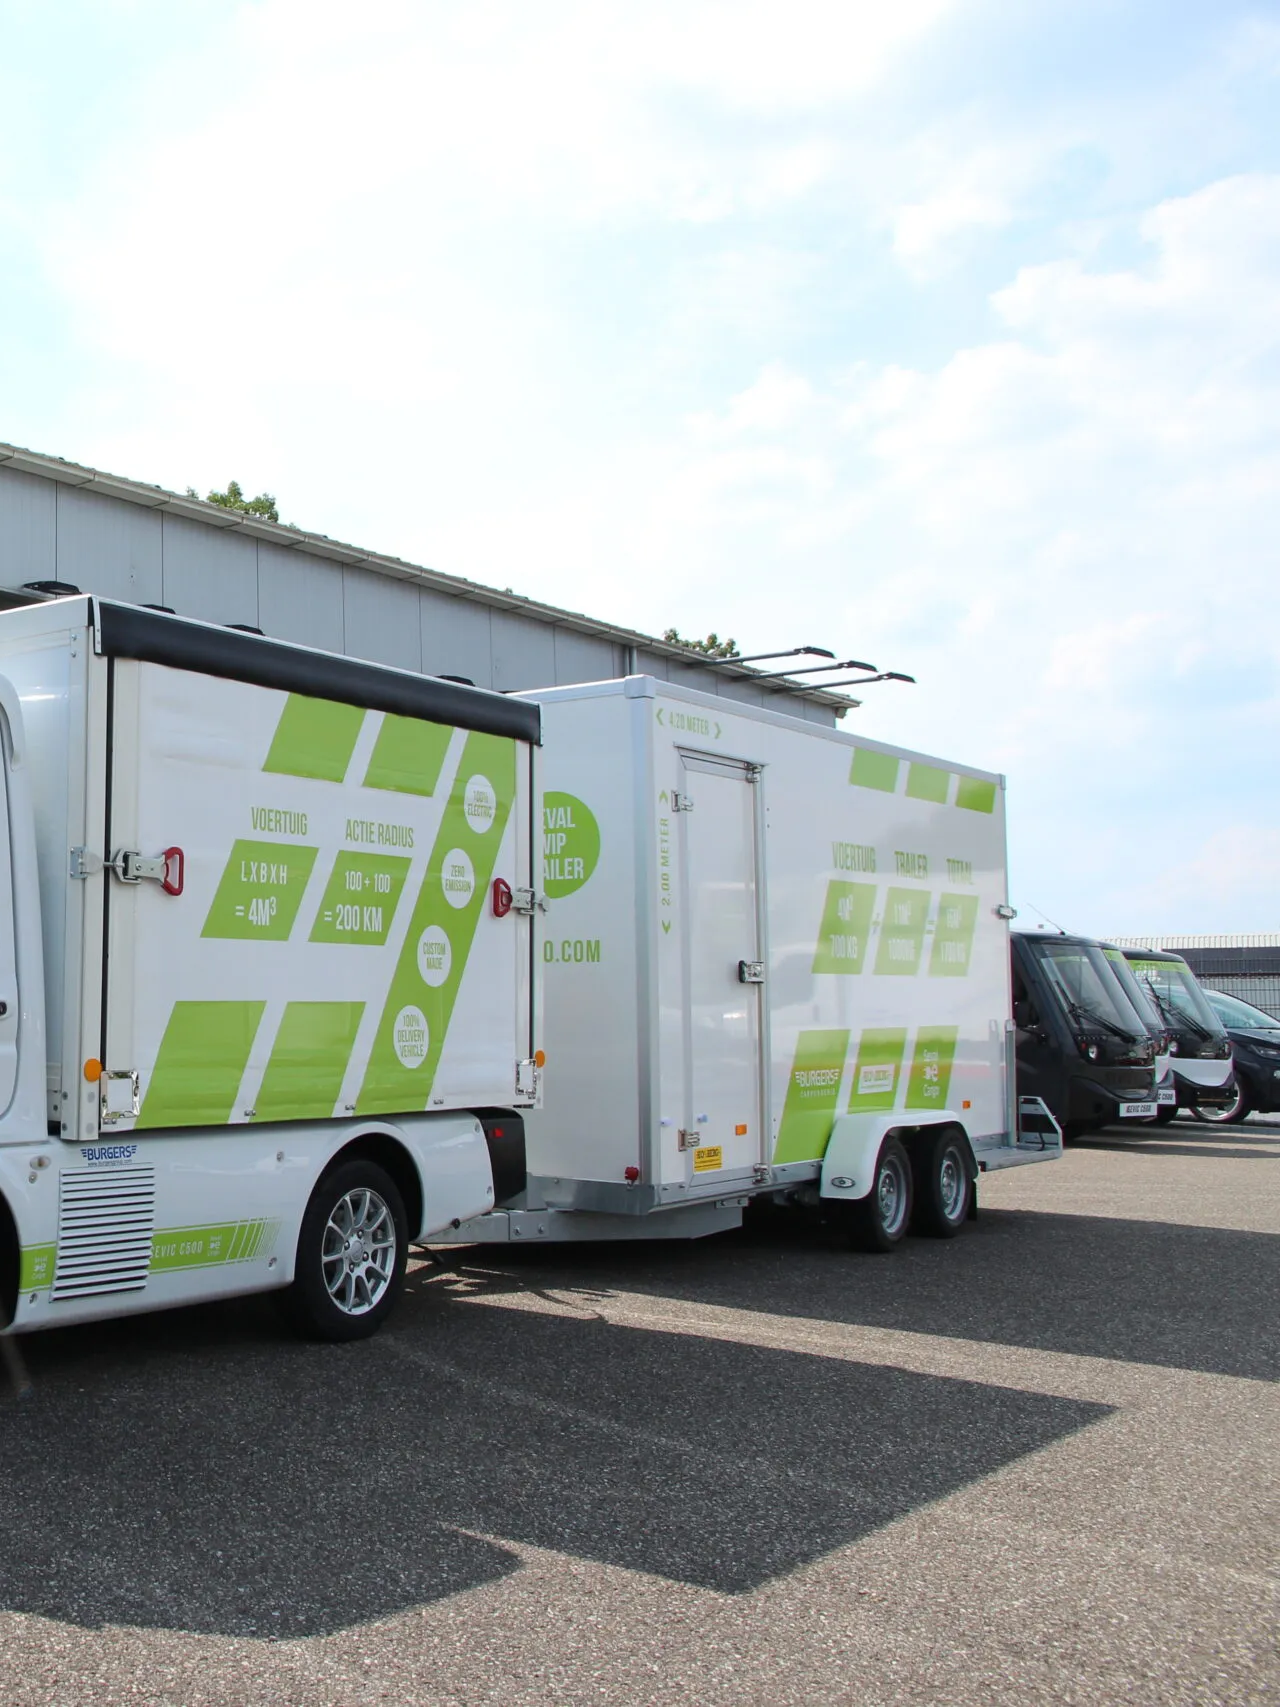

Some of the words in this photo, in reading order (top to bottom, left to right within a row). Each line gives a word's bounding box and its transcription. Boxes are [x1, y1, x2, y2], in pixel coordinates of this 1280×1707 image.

[686, 715, 710, 736] METER
[473, 790, 489, 803] 100%
[467, 803, 492, 818] ELECTRIC
[544, 807, 576, 829] VAL
[251, 806, 308, 836] VOERTUIG
[345, 819, 375, 844] ACTIE
[377, 823, 414, 848] RADIUS
[659, 818, 670, 867] METER
[832, 841, 877, 873] VOERTUIG
[451, 865, 465, 878] ZERO
[894, 851, 928, 880] TRAILER
[345, 870, 362, 890] 100
[374, 873, 390, 893] 100
[445, 879, 471, 893] EMISSION
[660, 872, 671, 906] 2.00
[336, 904, 360, 931] 200
[363, 906, 382, 932] KM
[423, 942, 446, 955] CUSTOM
[426, 957, 443, 970] MADE
[403, 1014, 420, 1027] 100%
[397, 1029, 425, 1043] DELIVERY
[399, 1043, 424, 1058] VEHICLE
[799, 1070, 835, 1087] BURGERS
[87, 1146, 132, 1161] BURGERS
[179, 1240, 204, 1256] C500
